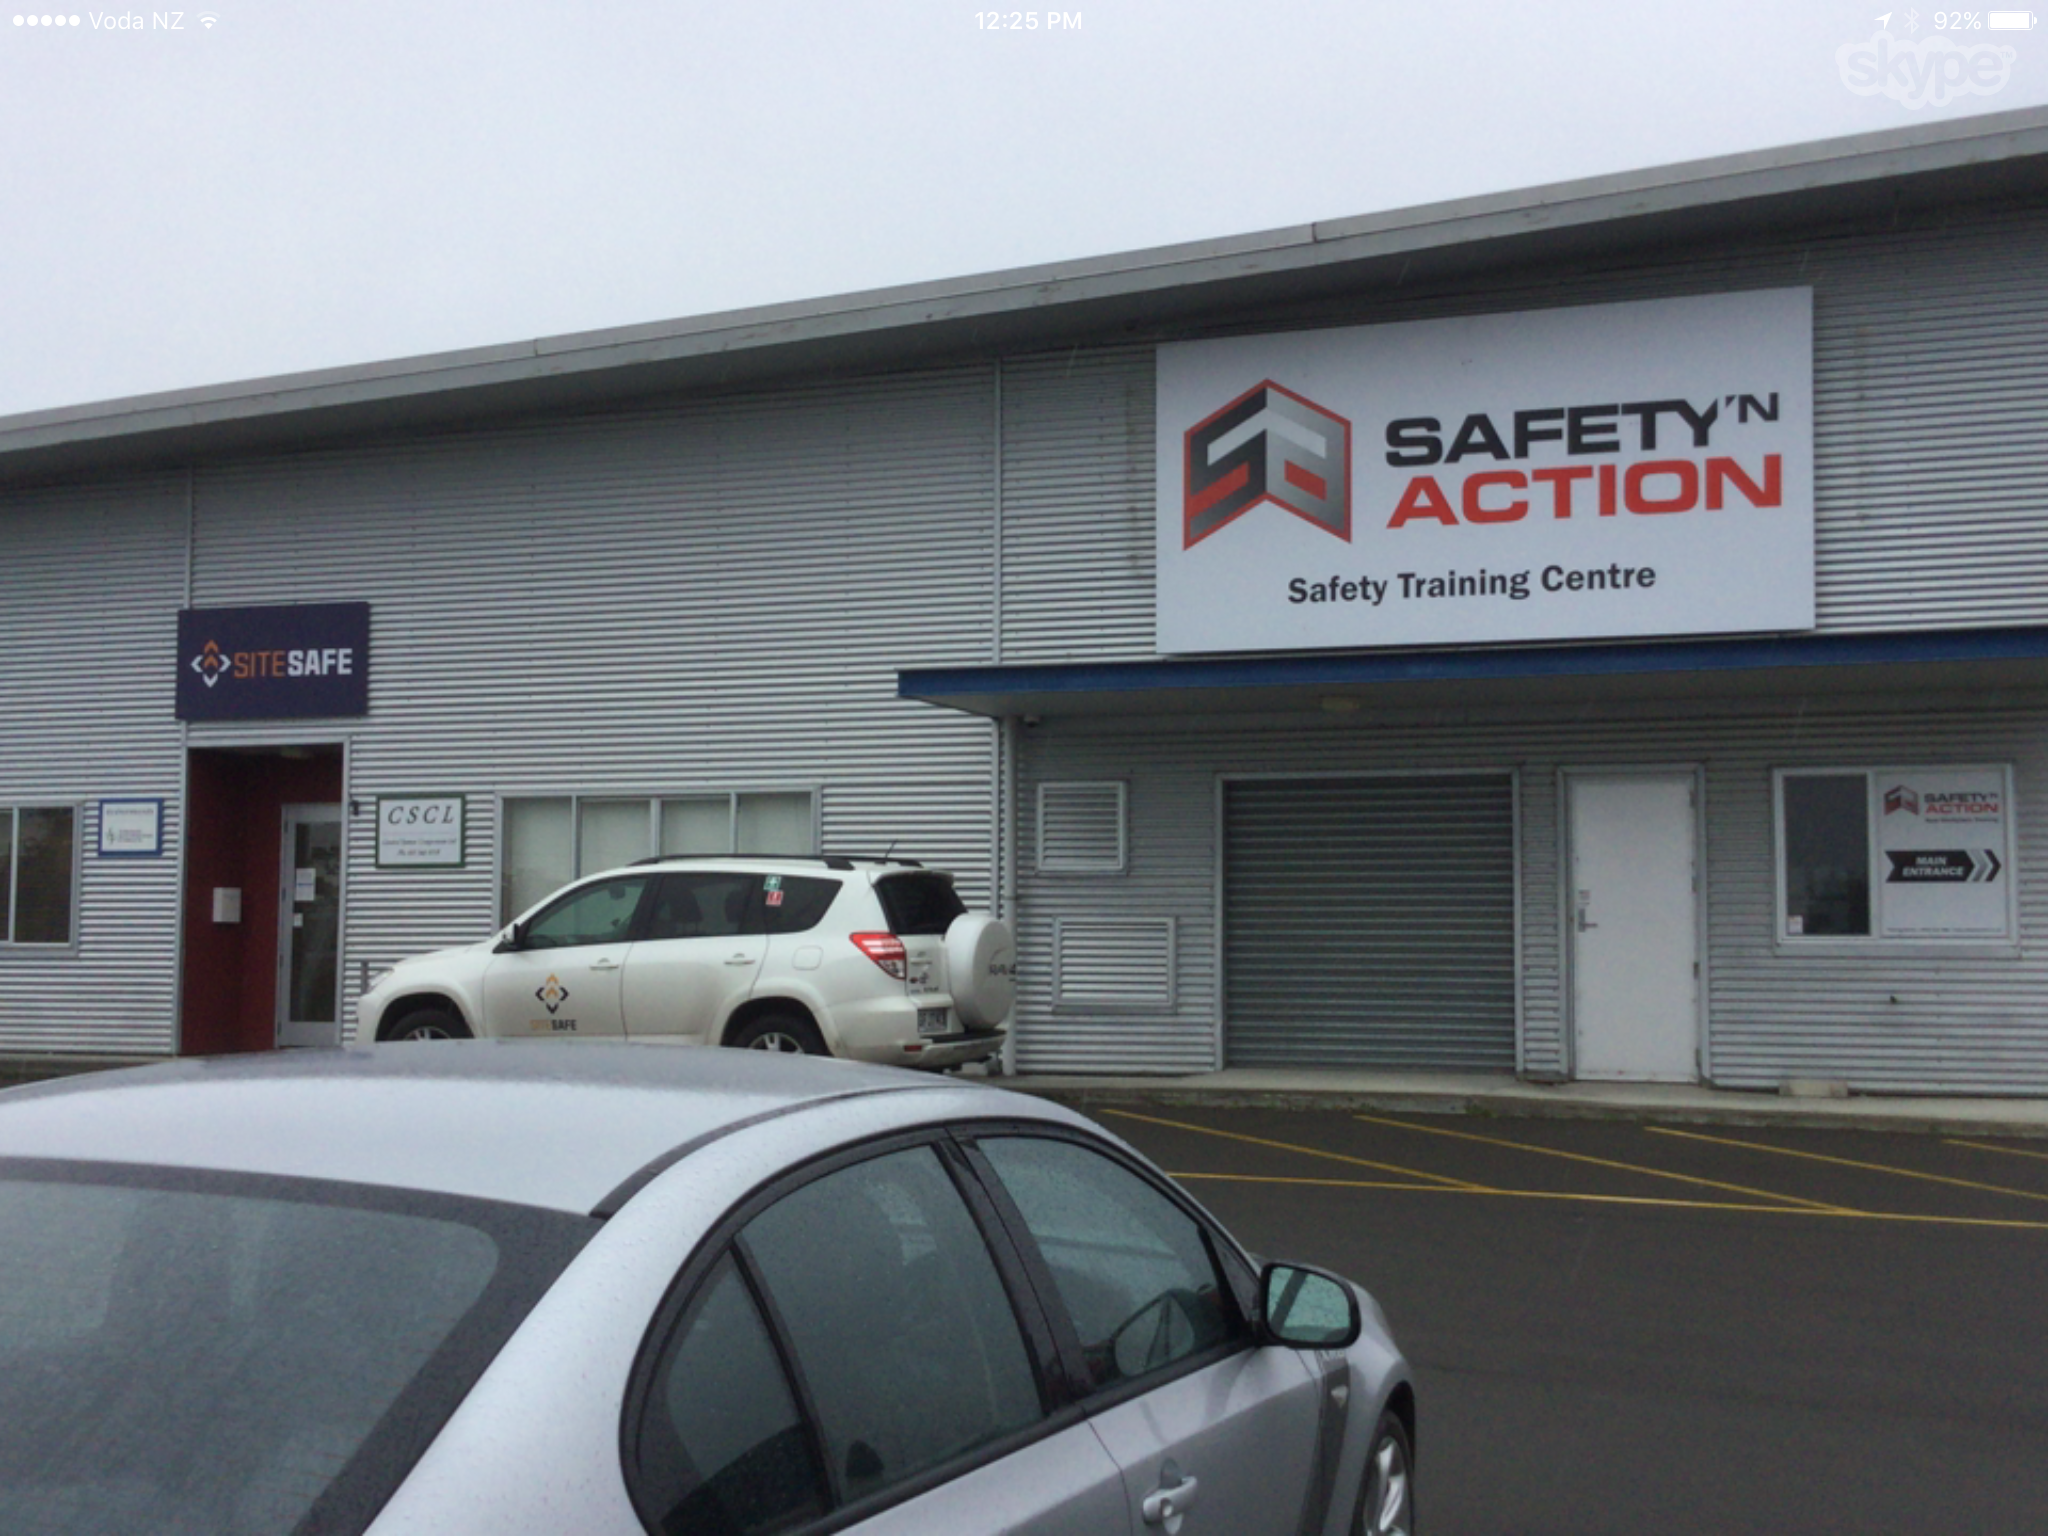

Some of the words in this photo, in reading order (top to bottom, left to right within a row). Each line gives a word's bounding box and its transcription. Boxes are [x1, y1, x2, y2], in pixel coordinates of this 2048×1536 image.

[1386, 453, 1782, 529] ACTION
[1287, 574, 1389, 607] Safety
[1397, 569, 1531, 601] Training
[1541, 561, 1657, 592] Centre
[1926, 803, 1998, 813] ACTION
[1916, 857, 1947, 865] MAIN
[1903, 866, 1964, 876] ENTRANCE
